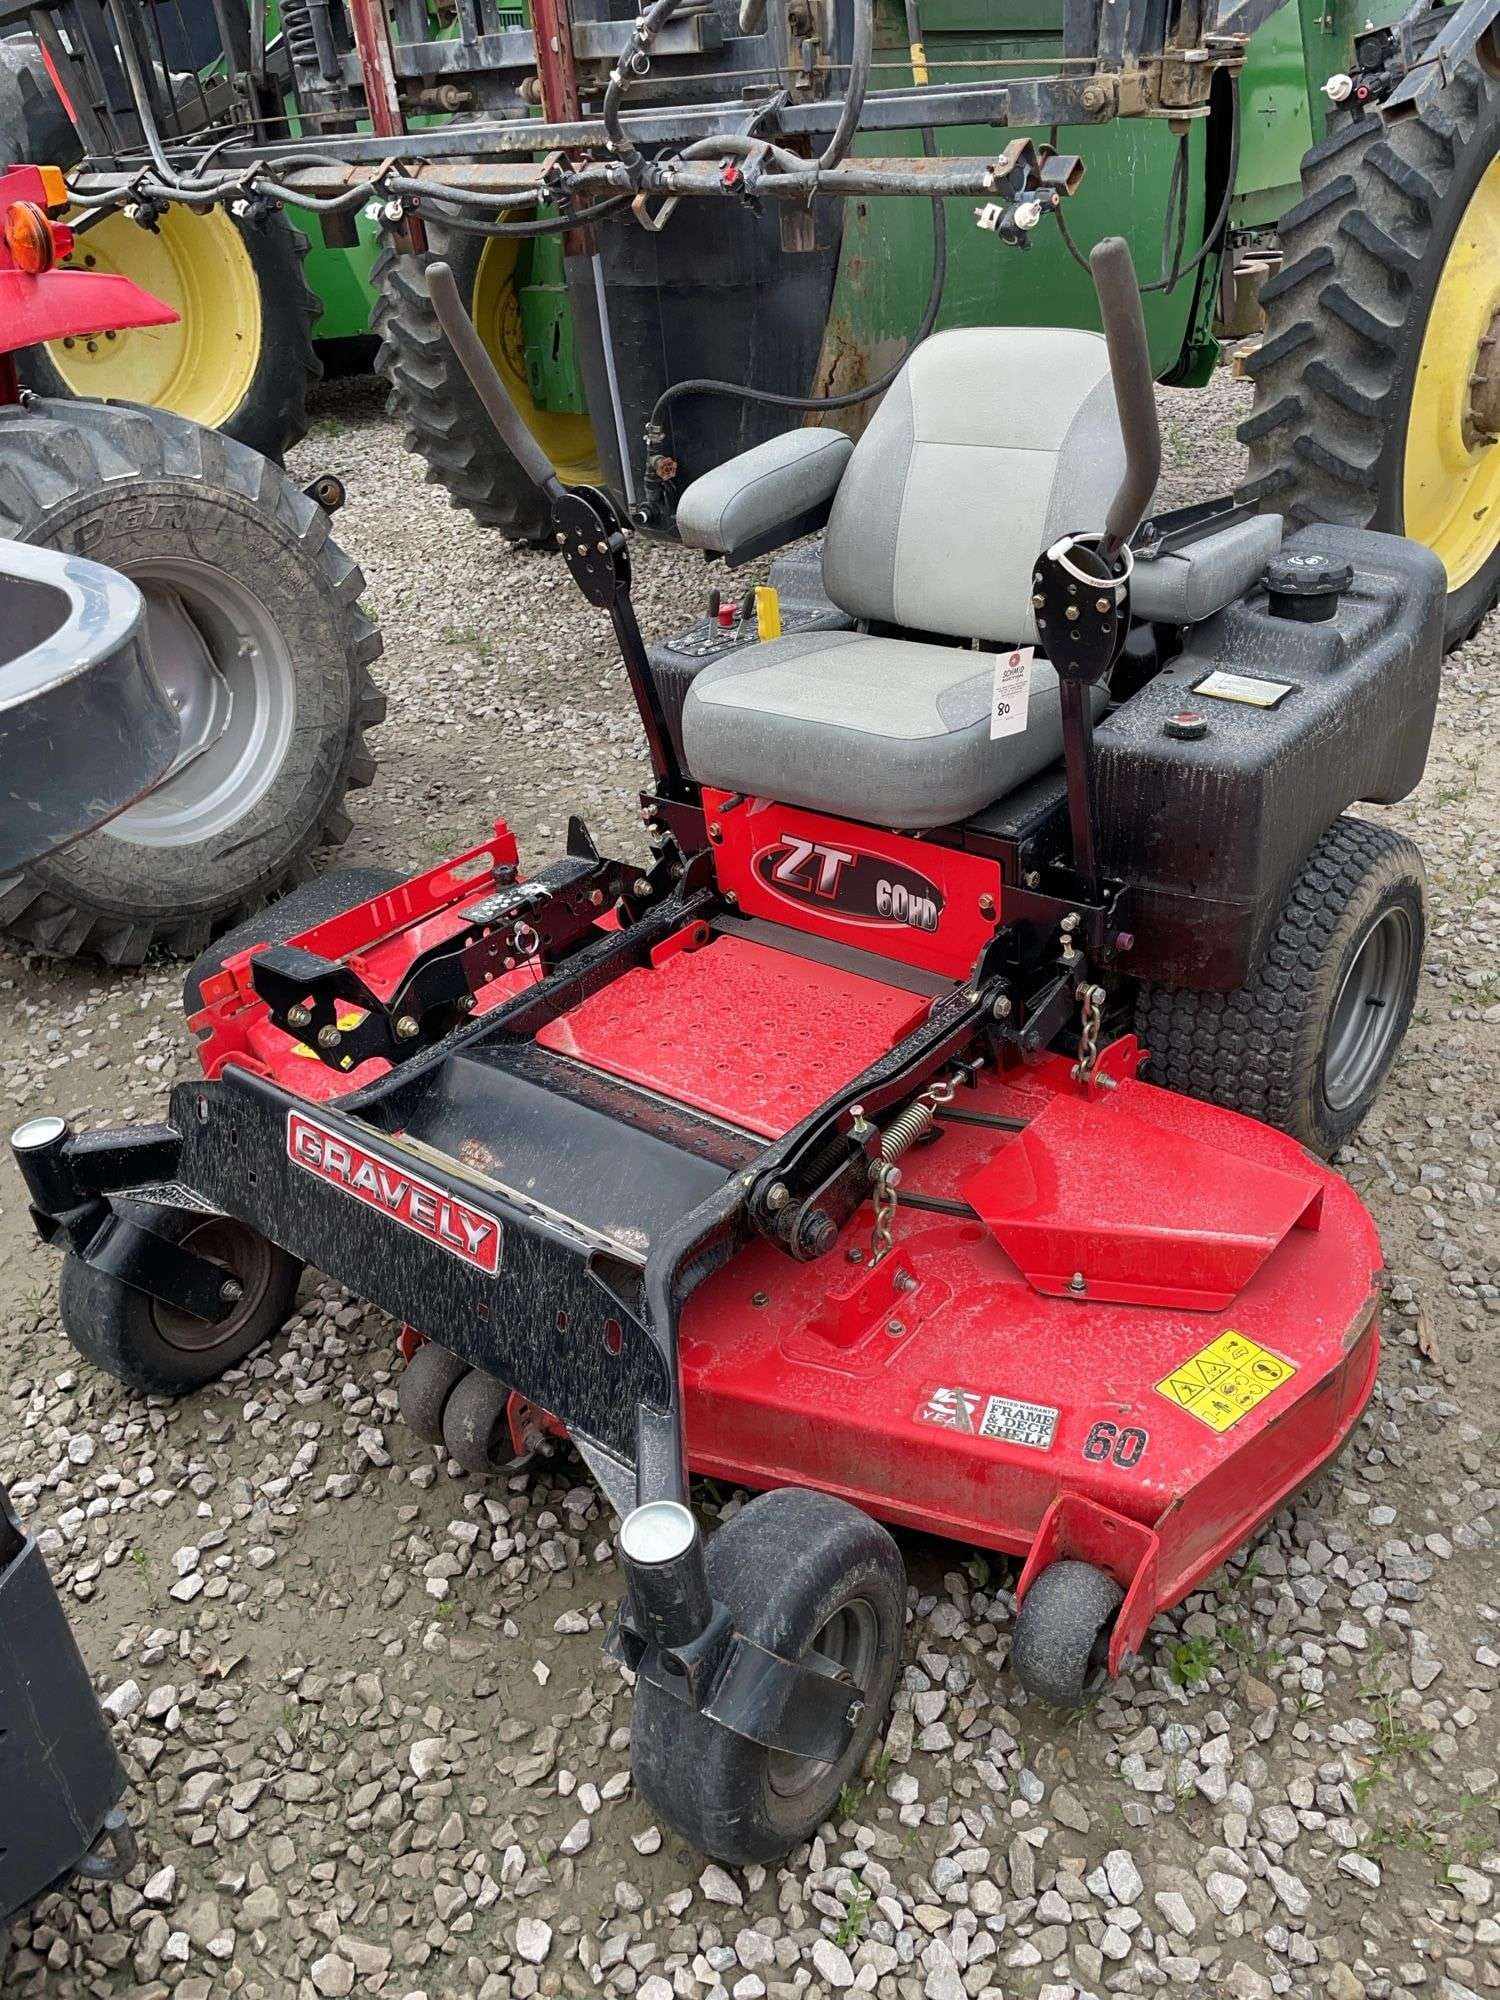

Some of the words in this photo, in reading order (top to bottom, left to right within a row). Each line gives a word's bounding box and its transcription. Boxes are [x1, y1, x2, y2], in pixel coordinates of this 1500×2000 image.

[997, 702, 1010, 716] 80
[774, 833, 855, 897] ZT
[876, 879, 938, 932] 60HD
[294, 1124, 492, 1255] GRAVELY
[921, 1406, 962, 1425] YEA
[989, 1403, 1054, 1426] FRAME
[992, 1398, 1019, 1408] LIMITED
[1019, 1403, 1055, 1415] WARRANTY
[983, 1423, 1049, 1448] SHELL
[987, 1413, 998, 1425] &
[1003, 1417, 1051, 1436] DECK
[1083, 1421, 1148, 1469] 60
